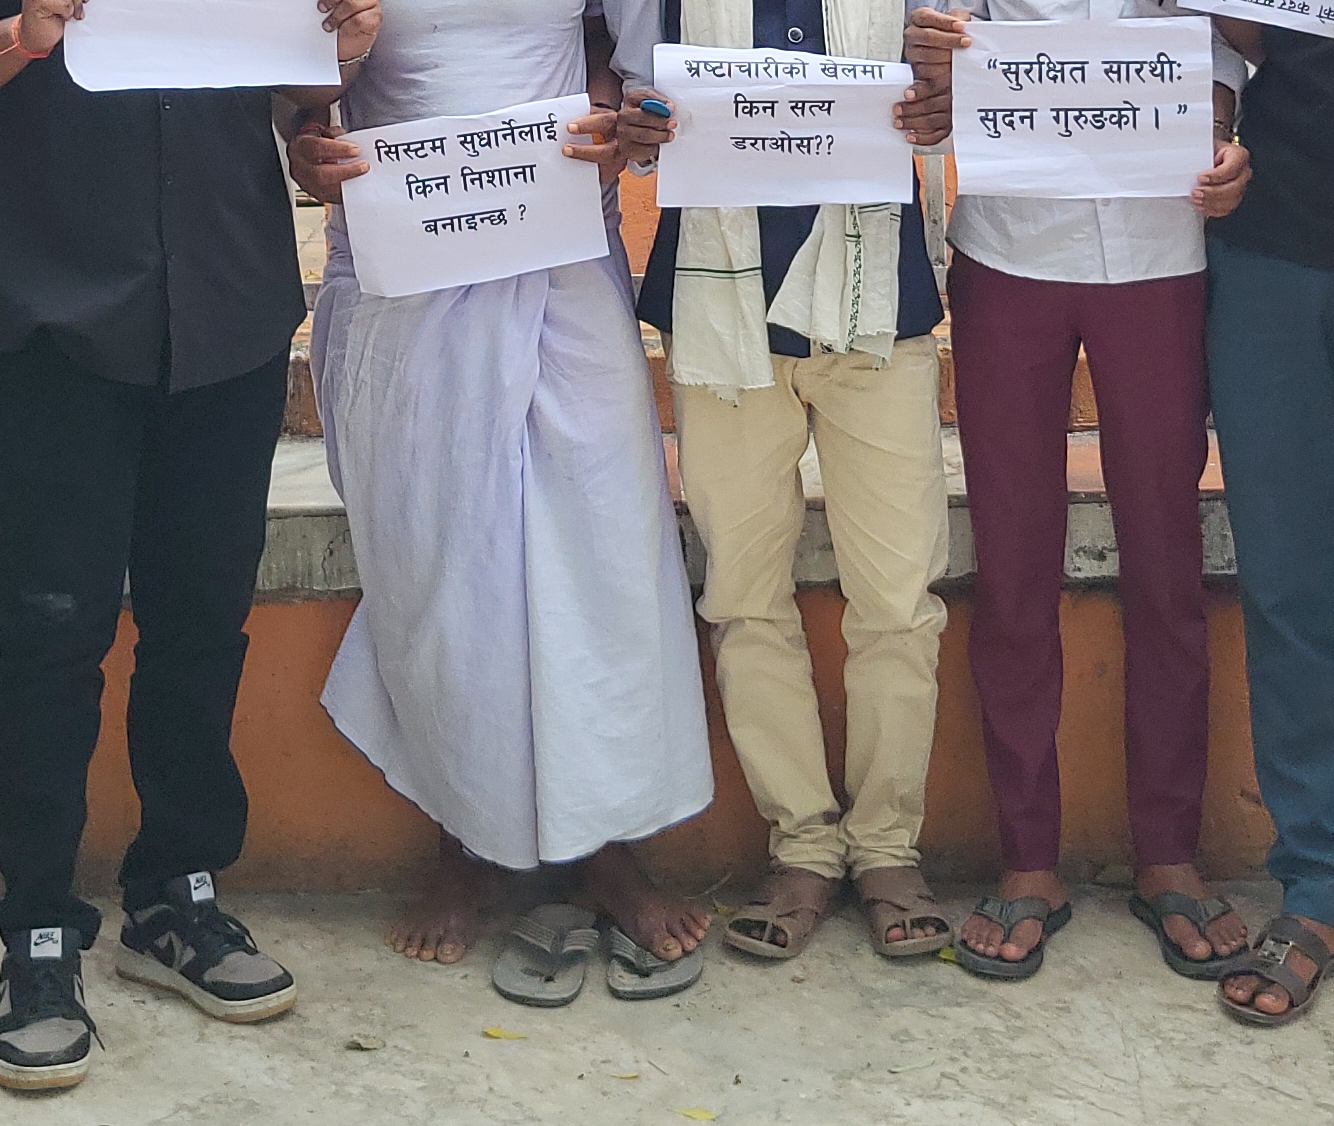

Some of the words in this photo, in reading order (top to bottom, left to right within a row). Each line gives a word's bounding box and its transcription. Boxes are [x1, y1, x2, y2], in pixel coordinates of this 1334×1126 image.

[683, 55, 810, 81] भ्रष्टाचारीको
[819, 58, 885, 81] खेलमा
[732, 92, 779, 119] किन
[788, 99, 836, 118] सत्य
[977, 107, 1039, 139] सुदन
[1049, 99, 1141, 137] गुरुङको
[374, 135, 447, 164] सिस्टम
[456, 112, 559, 158] सुधार्नेलाई
[405, 172, 451, 202] किन
[460, 163, 537, 194] निशाना
[421, 207, 508, 237] बनाइन्छ
[517, 203, 527, 222] ?
